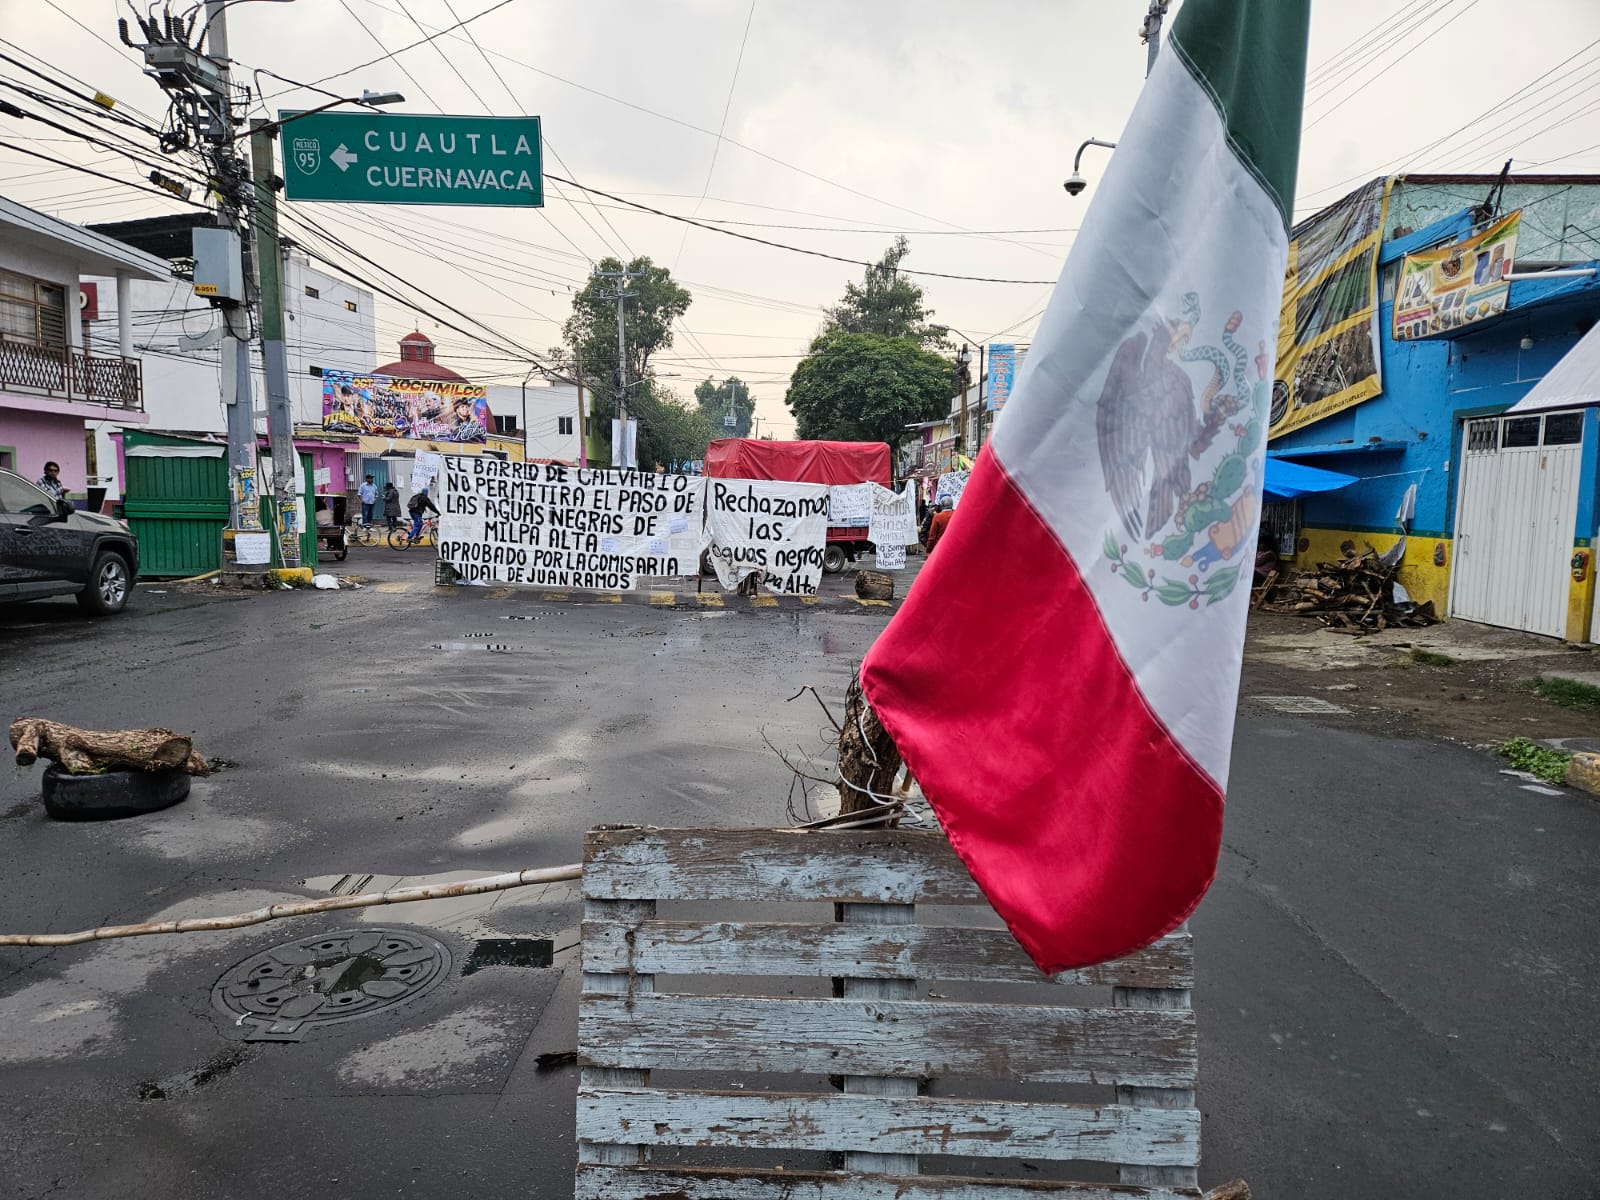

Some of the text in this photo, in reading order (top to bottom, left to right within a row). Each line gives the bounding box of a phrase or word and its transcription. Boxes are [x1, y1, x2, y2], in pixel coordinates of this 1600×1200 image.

[364, 130, 532, 155] CUAUTLA
[299, 152, 315, 168] 95
[366, 166, 534, 190] CUERNAVACA
[390, 378, 485, 397] XOCHIMILCO
[445, 457, 467, 472] EL
[545, 465, 568, 483] DE
[577, 469, 687, 492] CALVARIO
[447, 473, 695, 513] NO PERMITIRA EL PASO DE
[714, 482, 830, 519] Rechazamos
[446, 494, 477, 515] LAS
[485, 499, 544, 526] AGUAS
[549, 507, 623, 534] NEGRAS
[633, 515, 658, 537] DE
[485, 521, 540, 546] MILPA
[549, 528, 598, 553] ALTA
[440, 541, 678, 576] APROBADO POR LA COMISARIA
[775, 545, 824, 574] negras
[507, 566, 524, 582] DE
[527, 567, 569, 585] JUAN
[573, 571, 630, 589] RAMOS
[783, 574, 817, 595] Alta
